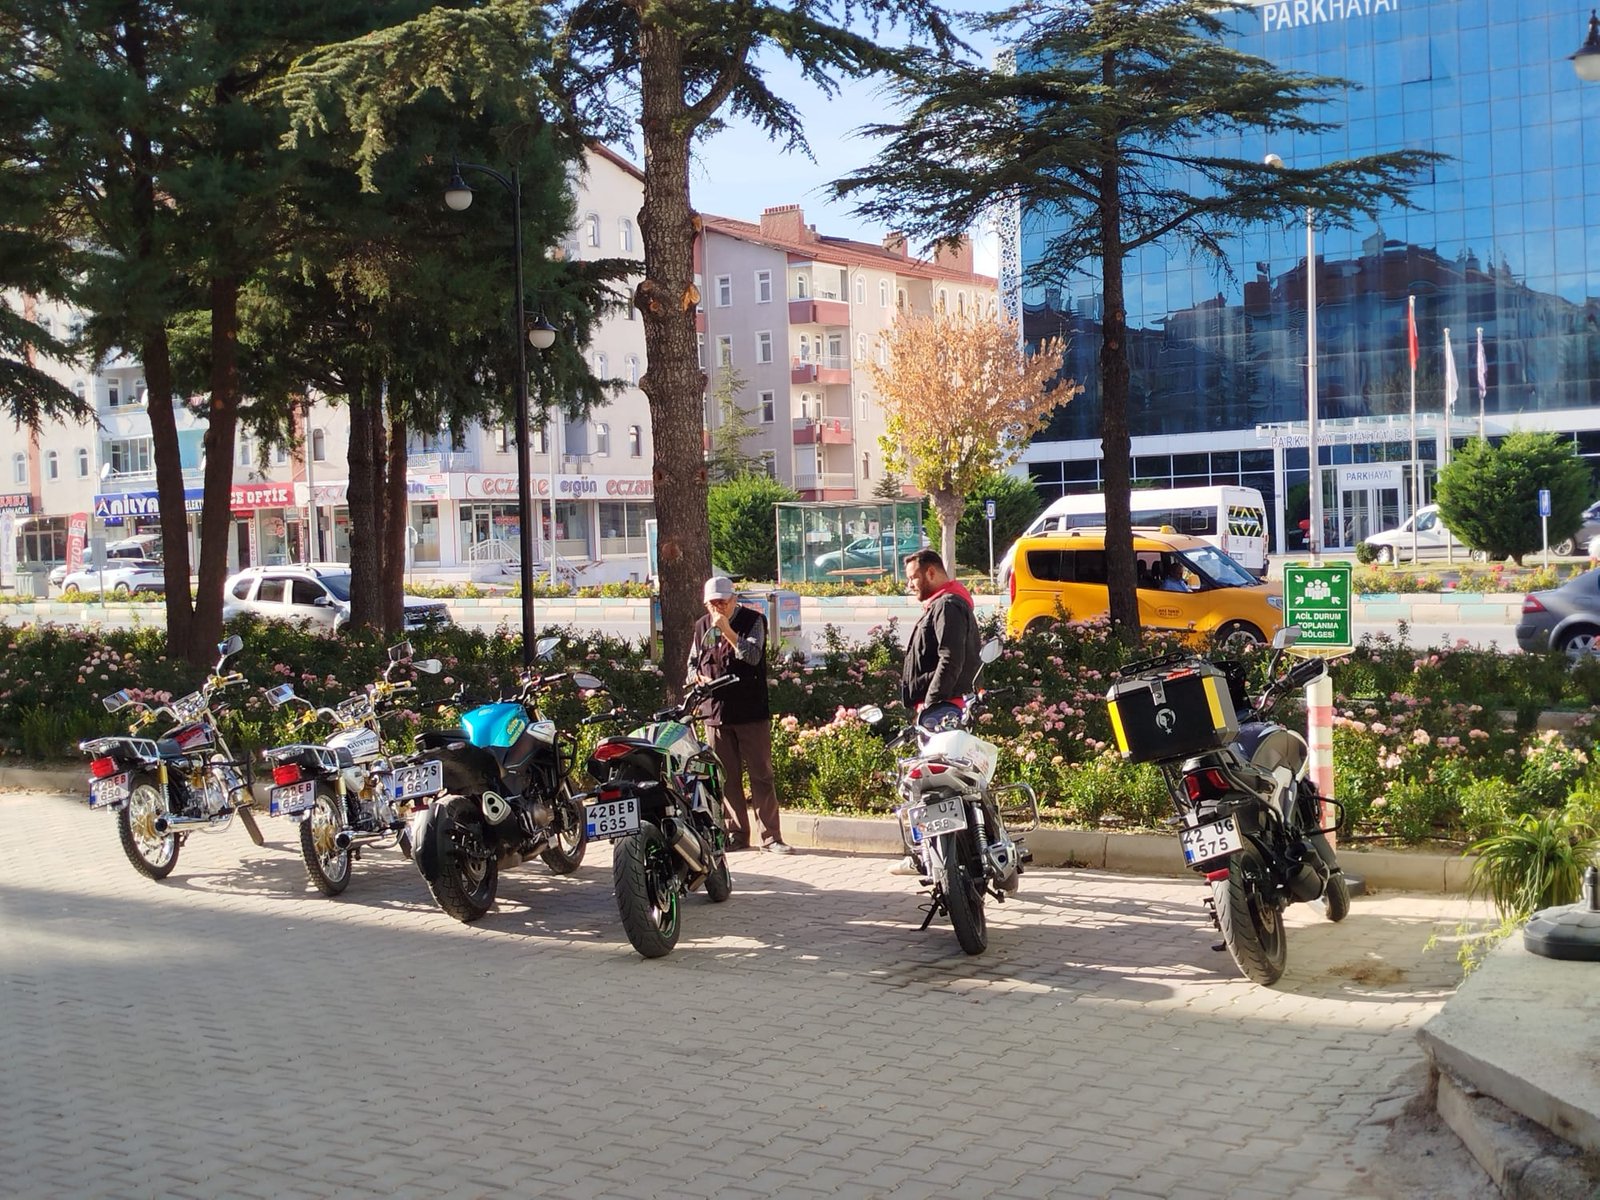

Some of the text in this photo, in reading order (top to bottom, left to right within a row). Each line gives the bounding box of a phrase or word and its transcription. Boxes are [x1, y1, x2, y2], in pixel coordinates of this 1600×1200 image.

[1346, 470, 1393, 481] PARKHAYAT
[482, 476, 654, 498] eczne ergün eczan
[1295, 612, 1312, 620] ACİL
[1301, 630, 1335, 638] BÖLGESİ
[407, 780, 429, 793] 961
[589, 801, 635, 819] 42BEB
[938, 801, 956, 813] UZ
[600, 817, 627, 832] 635
[1184, 819, 1234, 844] 42 UG
[1199, 837, 1229, 857] 575
